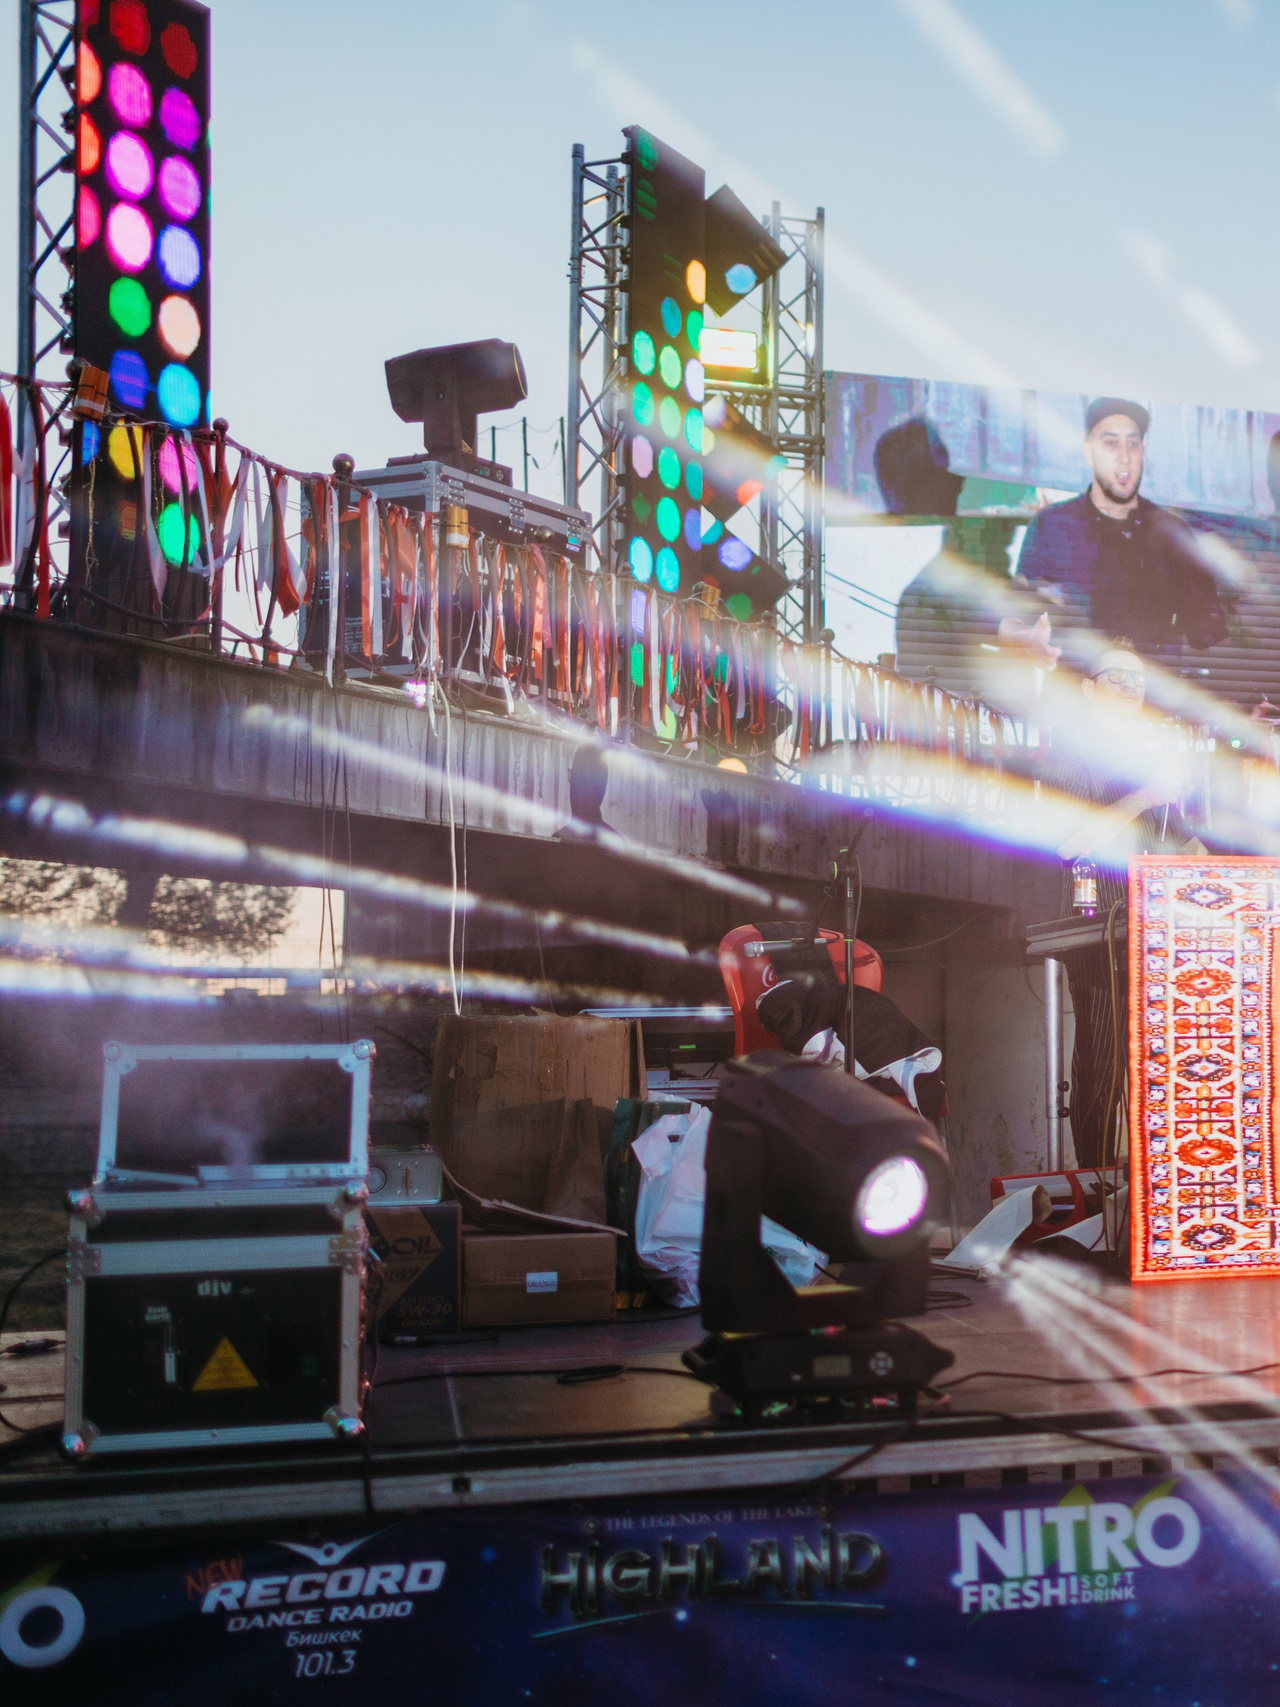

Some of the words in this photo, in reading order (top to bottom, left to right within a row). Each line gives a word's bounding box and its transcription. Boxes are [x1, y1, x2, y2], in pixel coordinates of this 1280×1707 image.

[398, 1302, 453, 1317] 5W-30
[607, 1517, 635, 1531] THE
[641, 1512, 711, 1528] LEGENDS
[715, 1511, 733, 1525] OF
[742, 1508, 772, 1522] THE
[776, 1505, 816, 1518] LAKE
[958, 1496, 1200, 1583] NITRO
[185, 1555, 244, 1600] NEW
[540, 1523, 885, 1617] HIGHLAND
[1081, 1572, 1134, 1588] SOFT
[200, 1560, 447, 1614] RECORD
[962, 1574, 1079, 1615] FRESH!
[1081, 1585, 1136, 1604] DRINK
[226, 1608, 324, 1632] DANCE
[329, 1600, 414, 1623] RADIO
[286, 1629, 364, 1648] Бишкек
[296, 1649, 358, 1678] 101.3
